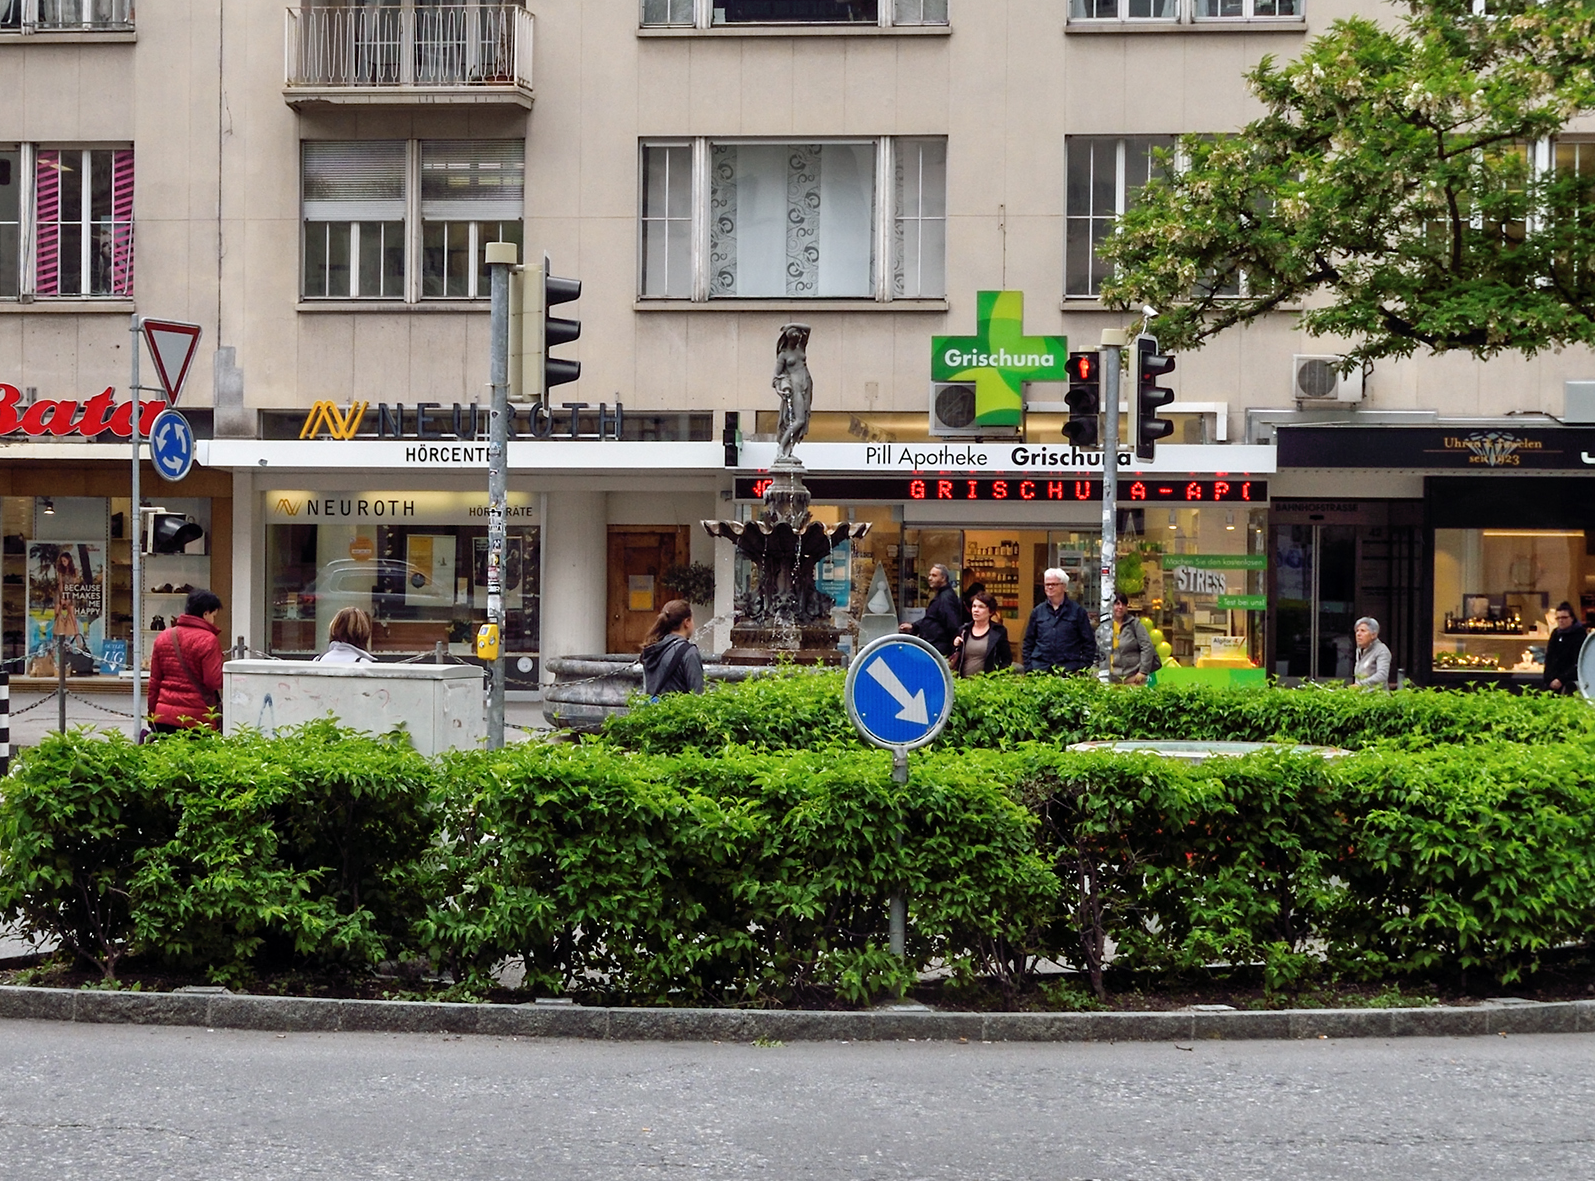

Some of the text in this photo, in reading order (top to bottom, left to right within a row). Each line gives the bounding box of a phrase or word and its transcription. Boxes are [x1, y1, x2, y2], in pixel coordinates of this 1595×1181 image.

[944, 348, 1054, 367] Grischuna
[405, 444, 491, 463] HÖRCENT
[866, 445, 1131, 471] Pill Apotheke Grischua
[307, 500, 415, 517] NEUROTH
[468, 505, 533, 517] HÖRRÄTE
[1275, 503, 1359, 512] BAHNHOFSTRASSE
[1208, 558, 1221, 566] den
[1176, 565, 1226, 595] STRESS
[64, 584, 101, 592] BECAUSE
[72, 592, 101, 600] MAKES
[1224, 598, 1236, 606] Test
[1238, 598, 1249, 606] bei
[88, 600, 101, 608] ME
[104, 651, 125, 664] UG
